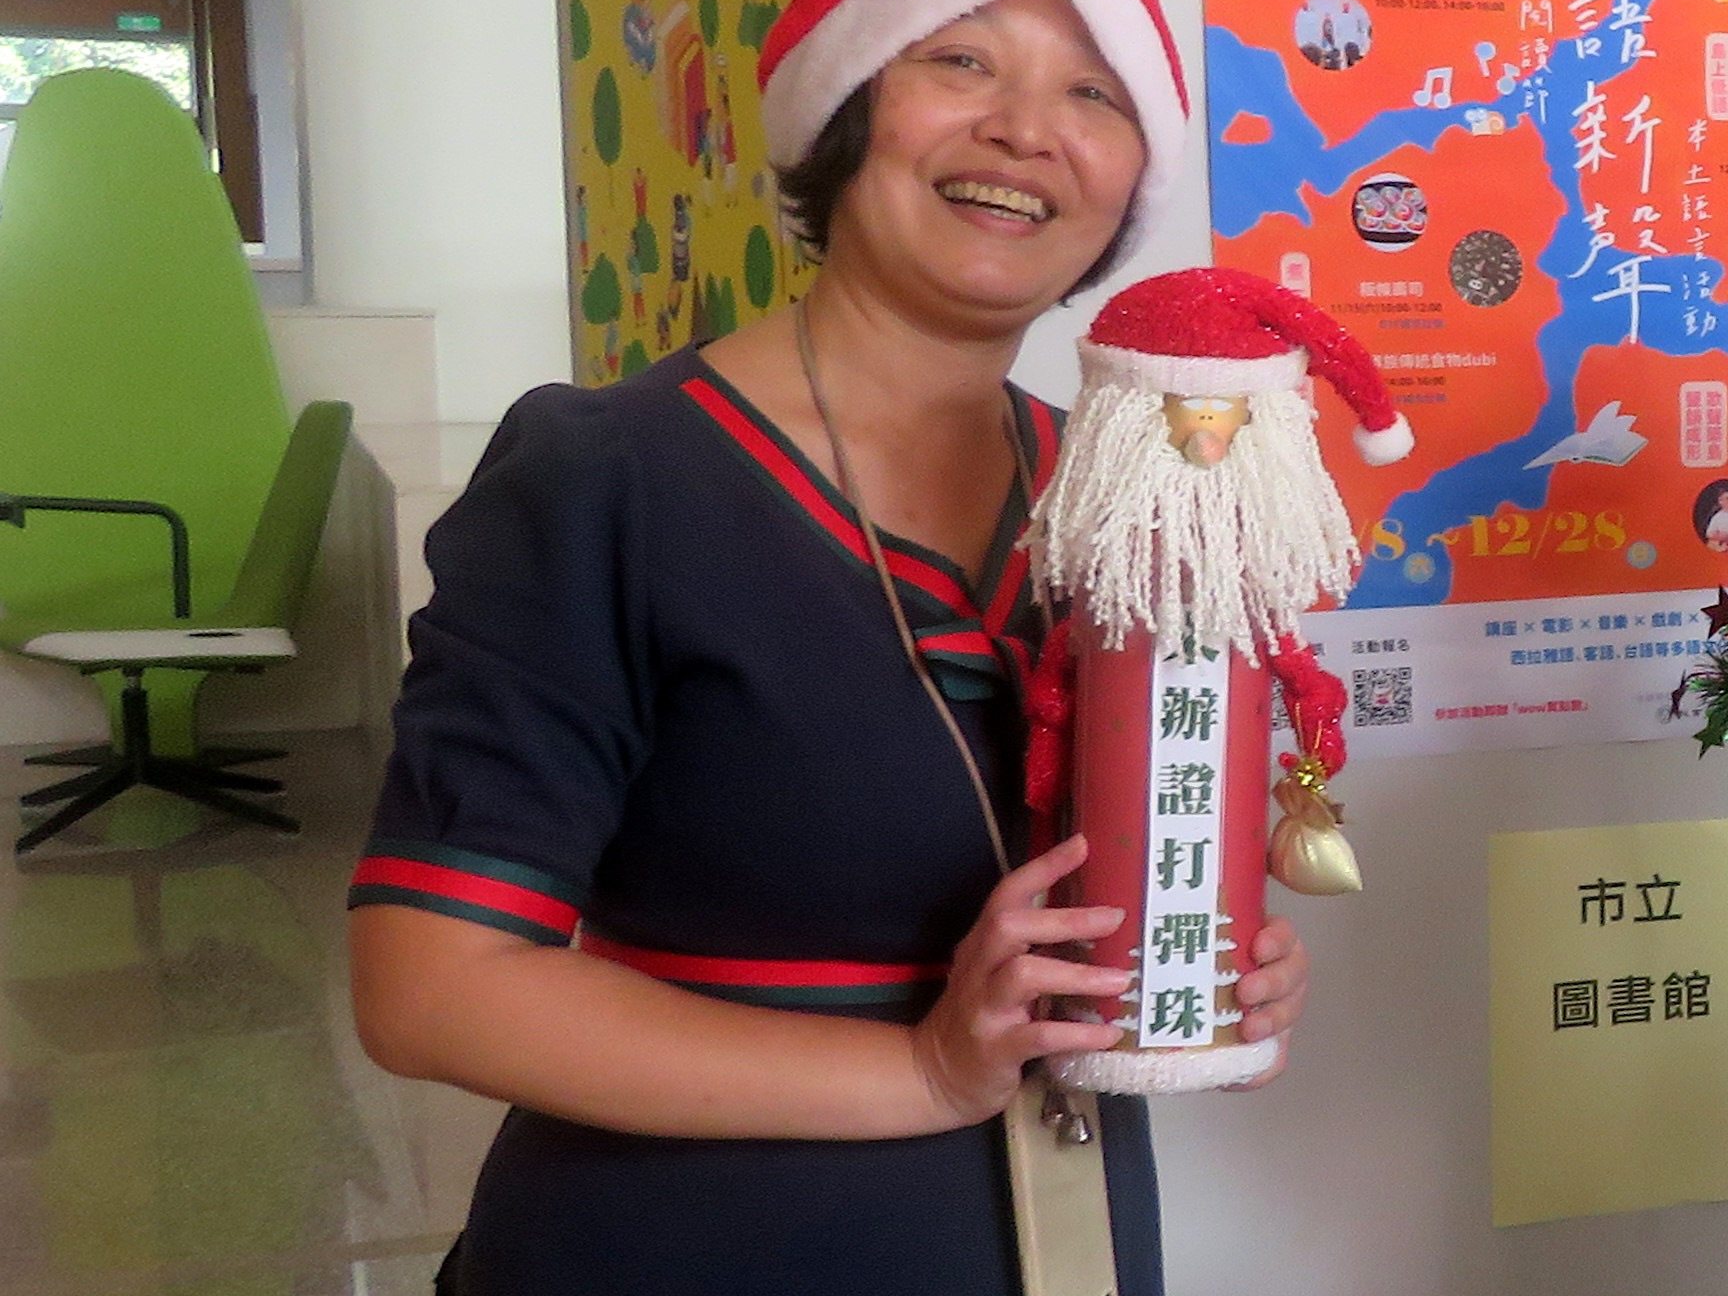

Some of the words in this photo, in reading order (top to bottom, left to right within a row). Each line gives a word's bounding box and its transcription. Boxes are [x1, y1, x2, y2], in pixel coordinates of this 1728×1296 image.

[1540, 617, 1574, 633] 電影
[1598, 615, 1629, 630] 音樂
[1352, 639, 1410, 654] 活動報名
[1577, 873, 1685, 929] 市立
[1552, 969, 1714, 1034] 圖書館
